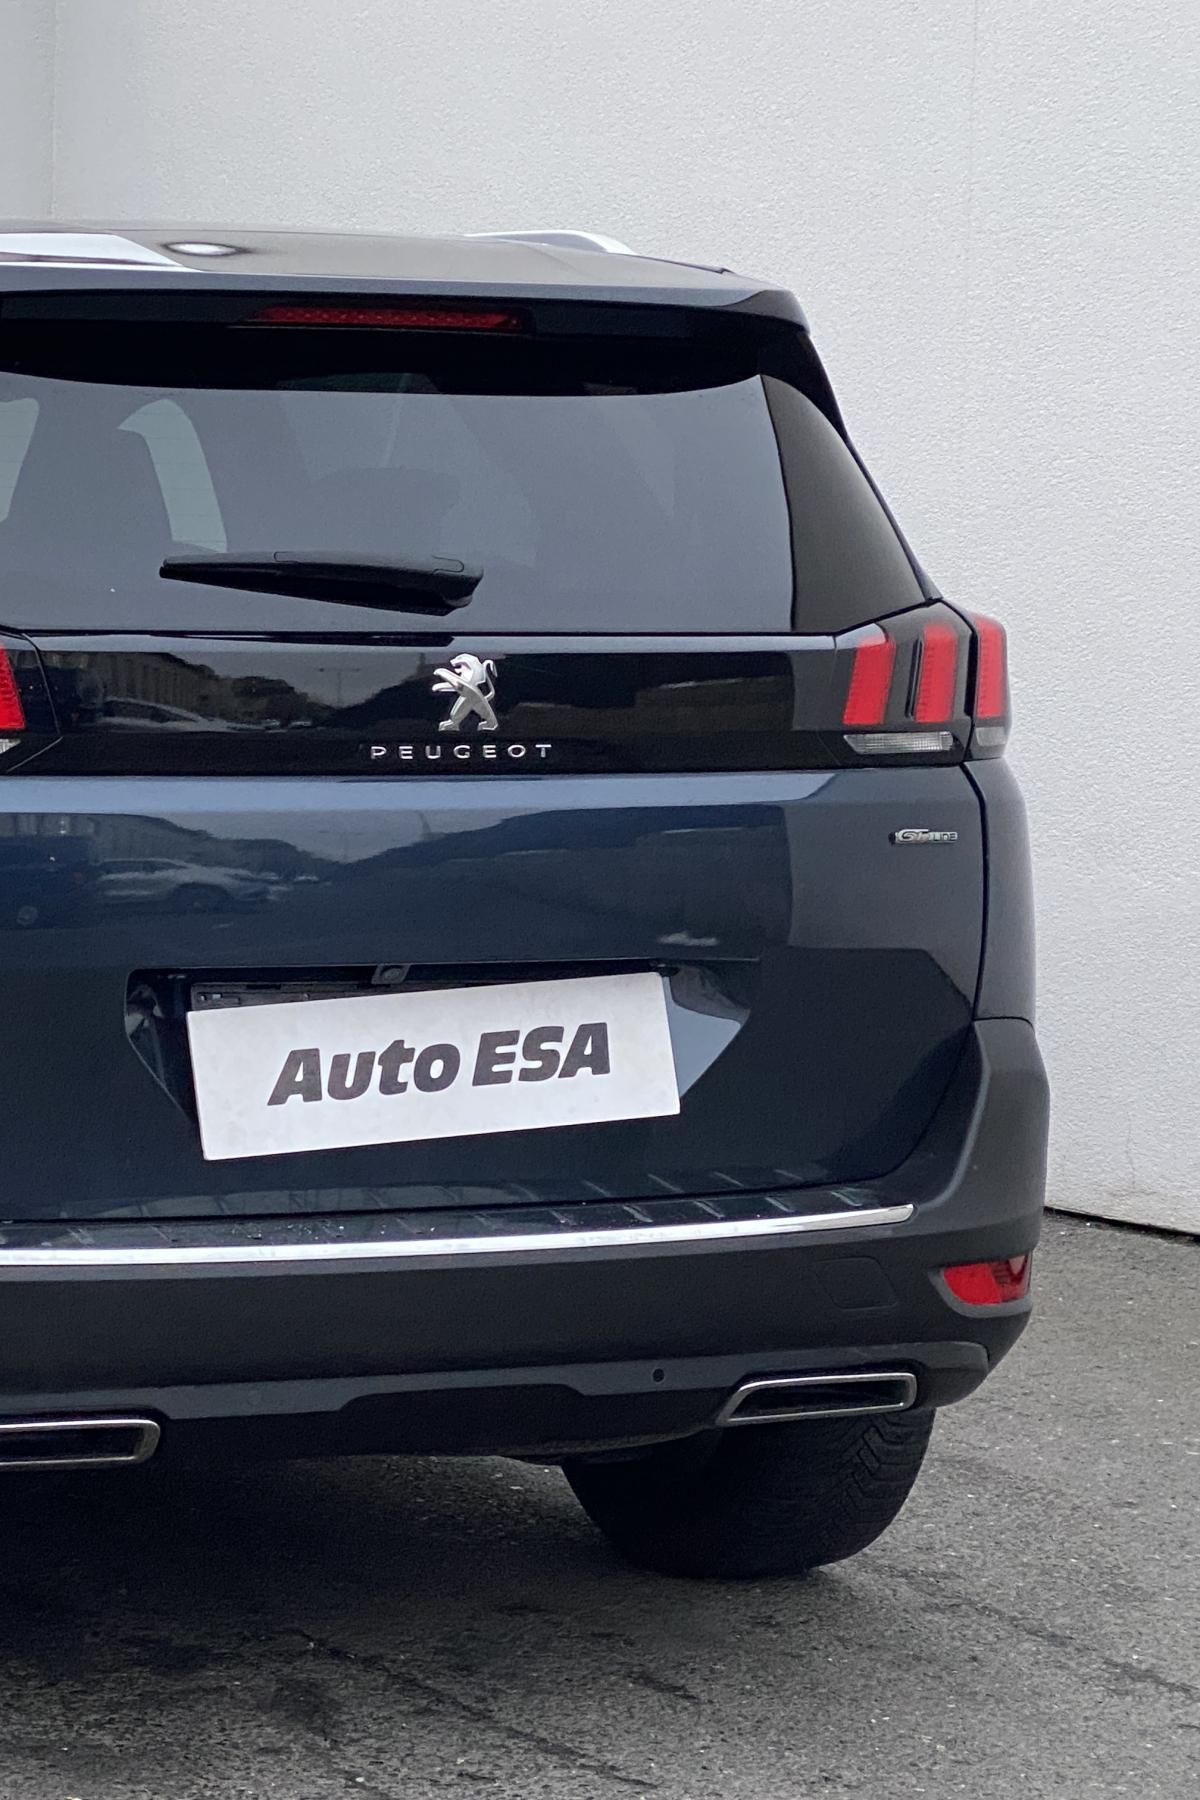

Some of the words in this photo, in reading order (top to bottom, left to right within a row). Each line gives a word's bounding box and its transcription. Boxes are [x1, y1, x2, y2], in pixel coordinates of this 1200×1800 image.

[370, 744, 552, 760] PEUGEOT
[266, 1038, 461, 1107] Auto
[471, 1021, 611, 1088] ESA
